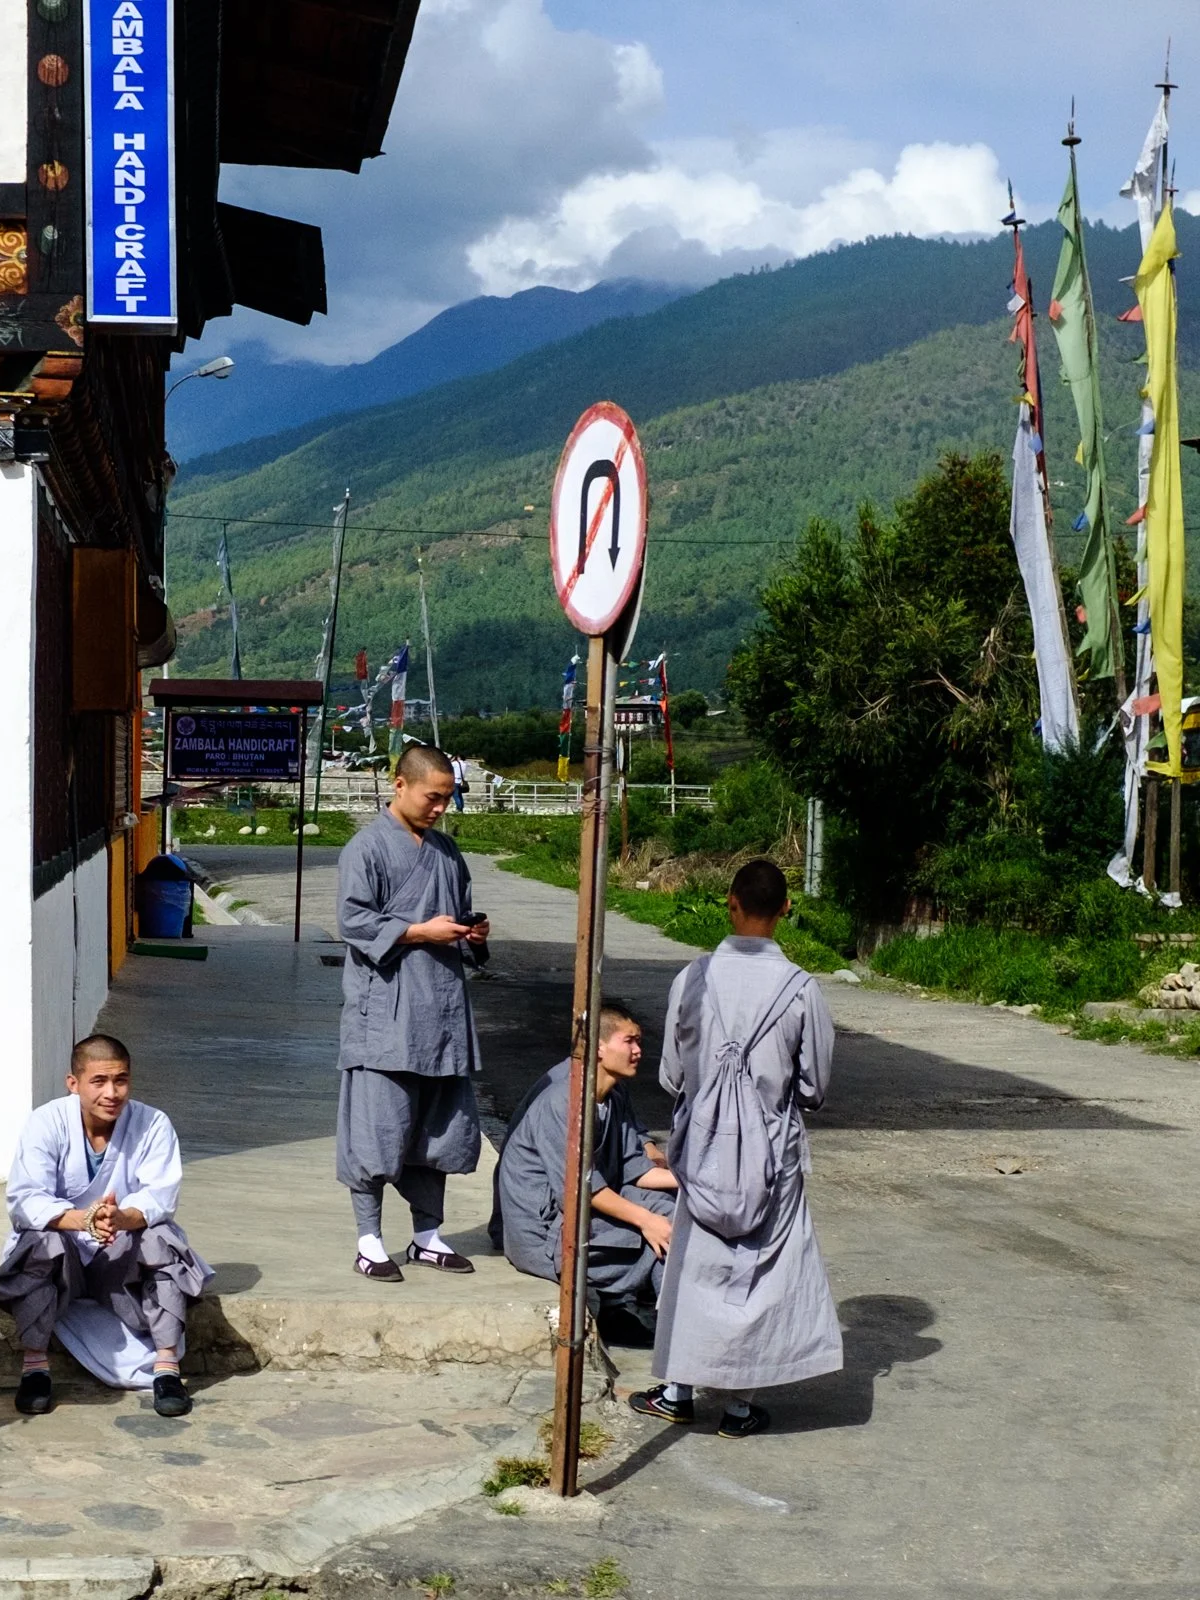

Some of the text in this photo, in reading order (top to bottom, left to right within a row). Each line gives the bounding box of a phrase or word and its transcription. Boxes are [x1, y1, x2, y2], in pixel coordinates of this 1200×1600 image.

[113, 133, 147, 313] HANDICRAFT
[174, 737, 297, 752] ZAMBALA HANDICRAFT
[205, 752, 226, 760] PARO
[232, 753, 265, 761] BHUTAN
